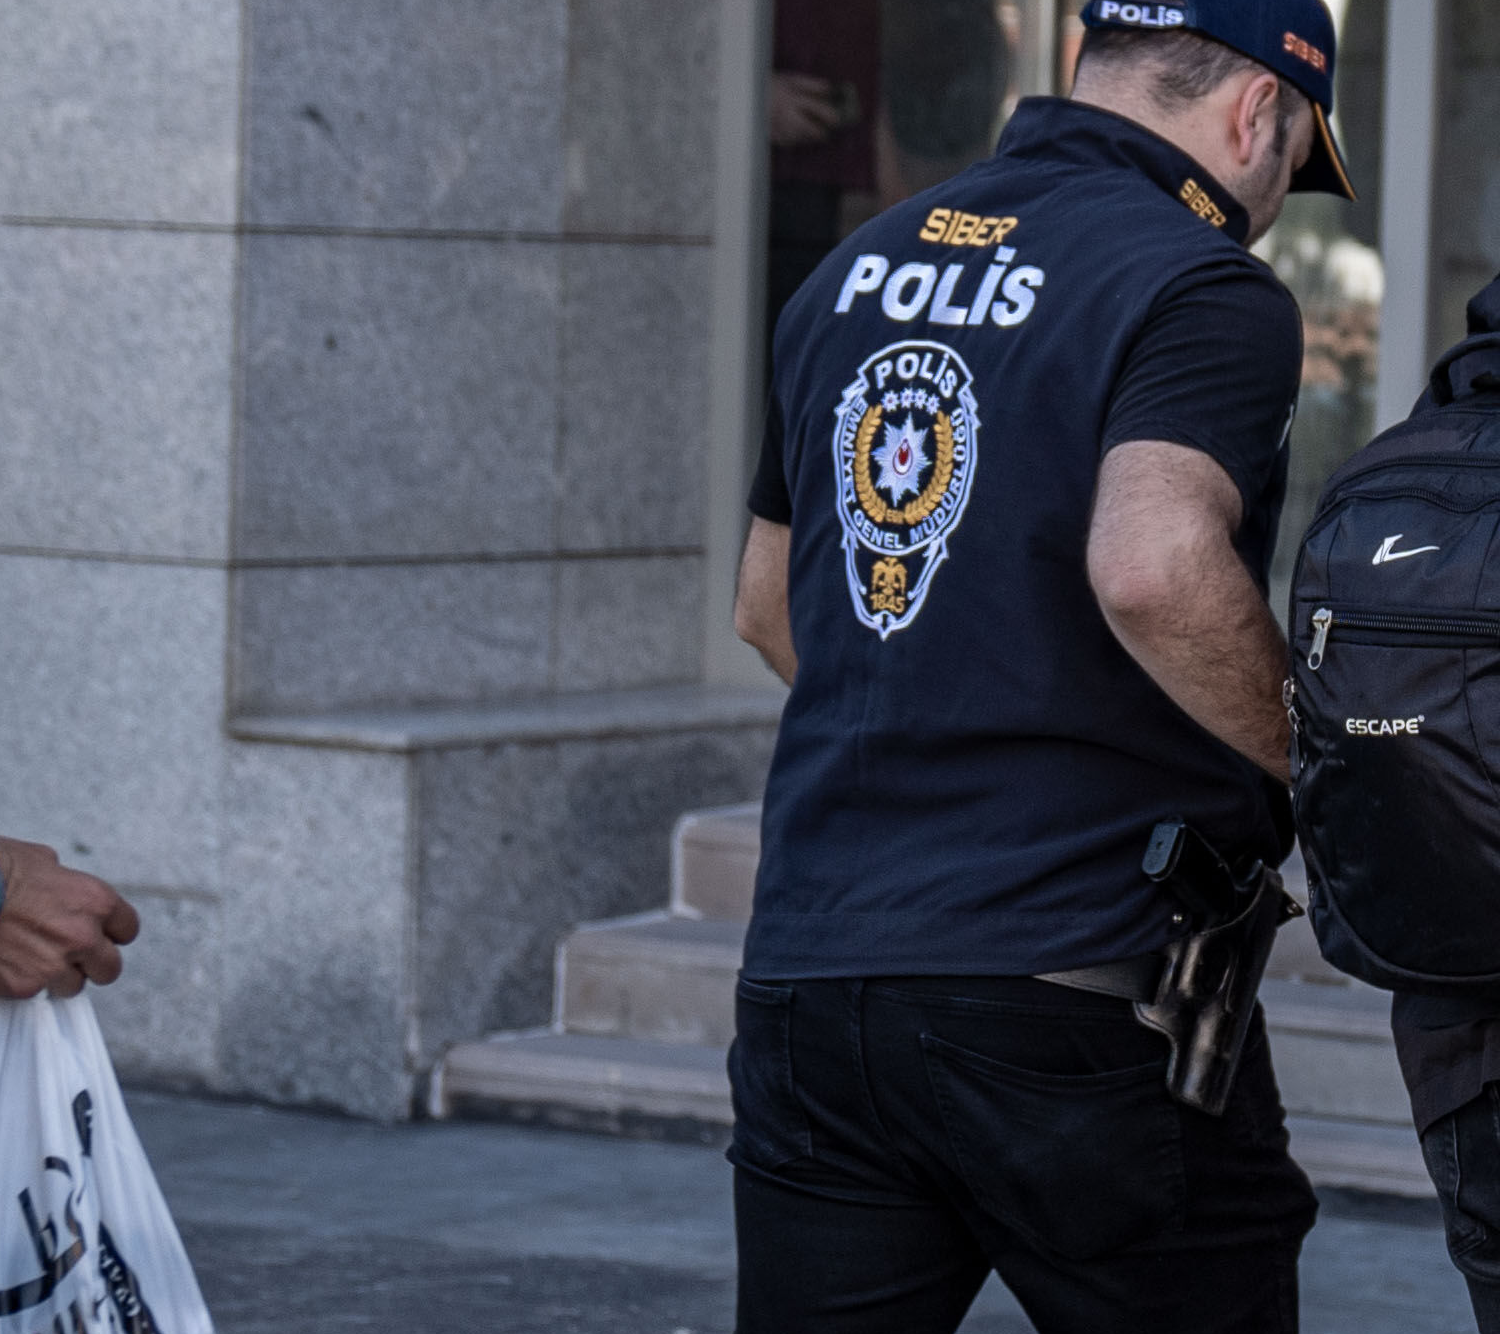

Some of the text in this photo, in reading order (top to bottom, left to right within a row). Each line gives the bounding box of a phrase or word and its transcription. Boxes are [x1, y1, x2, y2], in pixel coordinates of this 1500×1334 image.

[1101, 0, 1185, 28] POLİS
[834, 245, 1046, 327] POLİS
[874, 351, 958, 399] POLİS
[852, 508, 905, 550] GENEL
[870, 593, 905, 613] 1845
